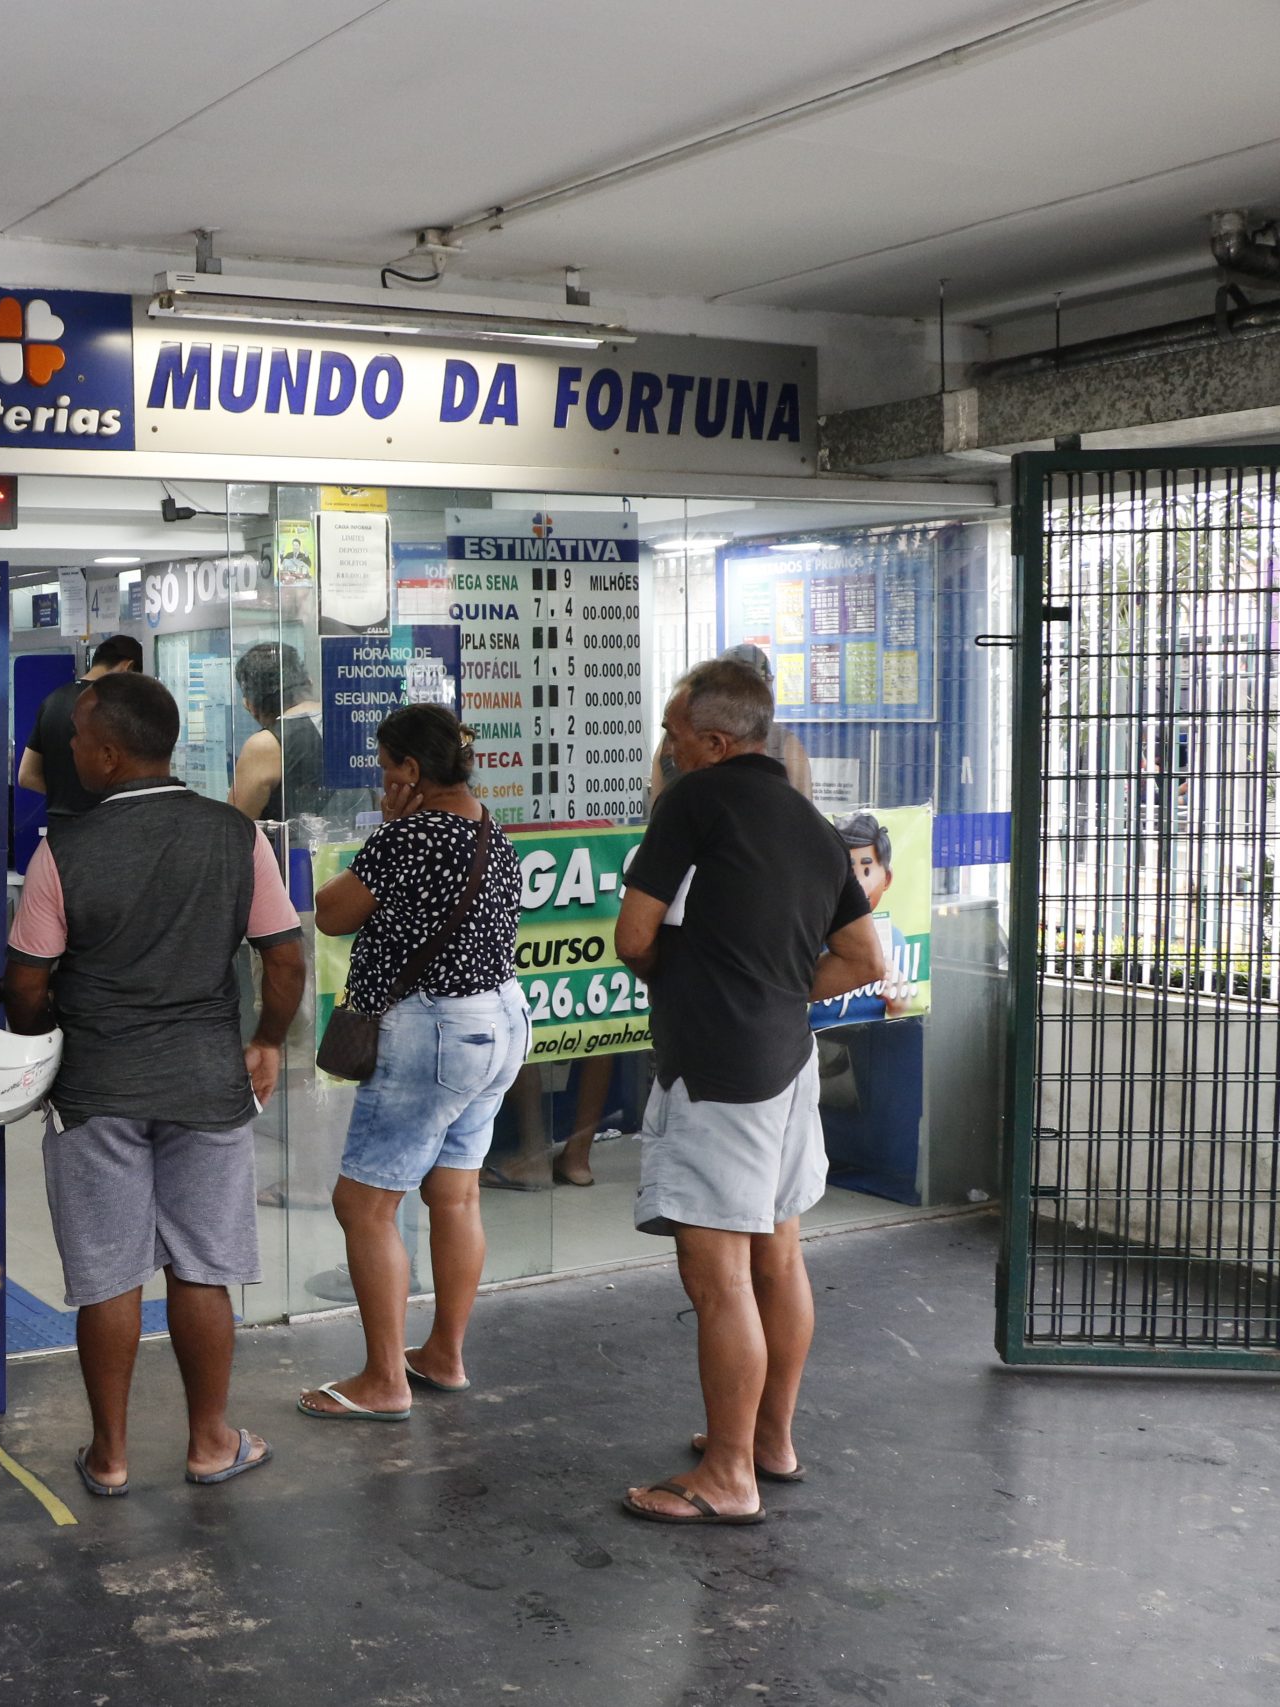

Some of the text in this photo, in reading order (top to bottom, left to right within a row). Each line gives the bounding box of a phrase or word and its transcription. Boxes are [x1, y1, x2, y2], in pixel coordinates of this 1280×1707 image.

[146, 340, 800, 443] MUNDO DA FORTUNA
[464, 537, 622, 561] ESTIMATIVA
[145, 562, 179, 614] SÓ
[447, 574, 482, 591] MEGA
[486, 574, 518, 591] SENA
[564, 568, 572, 588] 9
[449, 603, 519, 621] QUINA
[583, 605, 639, 621] 00.000,00
[489, 632, 519, 650] SENA
[565, 626, 573, 646] 4
[584, 634, 640, 650] 00.000,00
[353, 644, 432, 660] HORÁRIO DE
[337, 664, 447, 679] FUNCIONAMENTO
[584, 662, 641, 679] 00.000,00
[334, 691, 398, 706] SEGUNDA
[567, 686, 575, 706] 7
[585, 691, 641, 707] 00.000,00
[351, 709, 382, 723] 08:00
[585, 719, 642, 736] 00.000,00
[567, 743, 574, 764] 7
[585, 747, 642, 764] 00.000,00
[492, 782, 524, 798] sorte
[568, 773, 575, 794] 3
[586, 776, 642, 793] 00.000,00
[586, 800, 643, 817] 00.000,00
